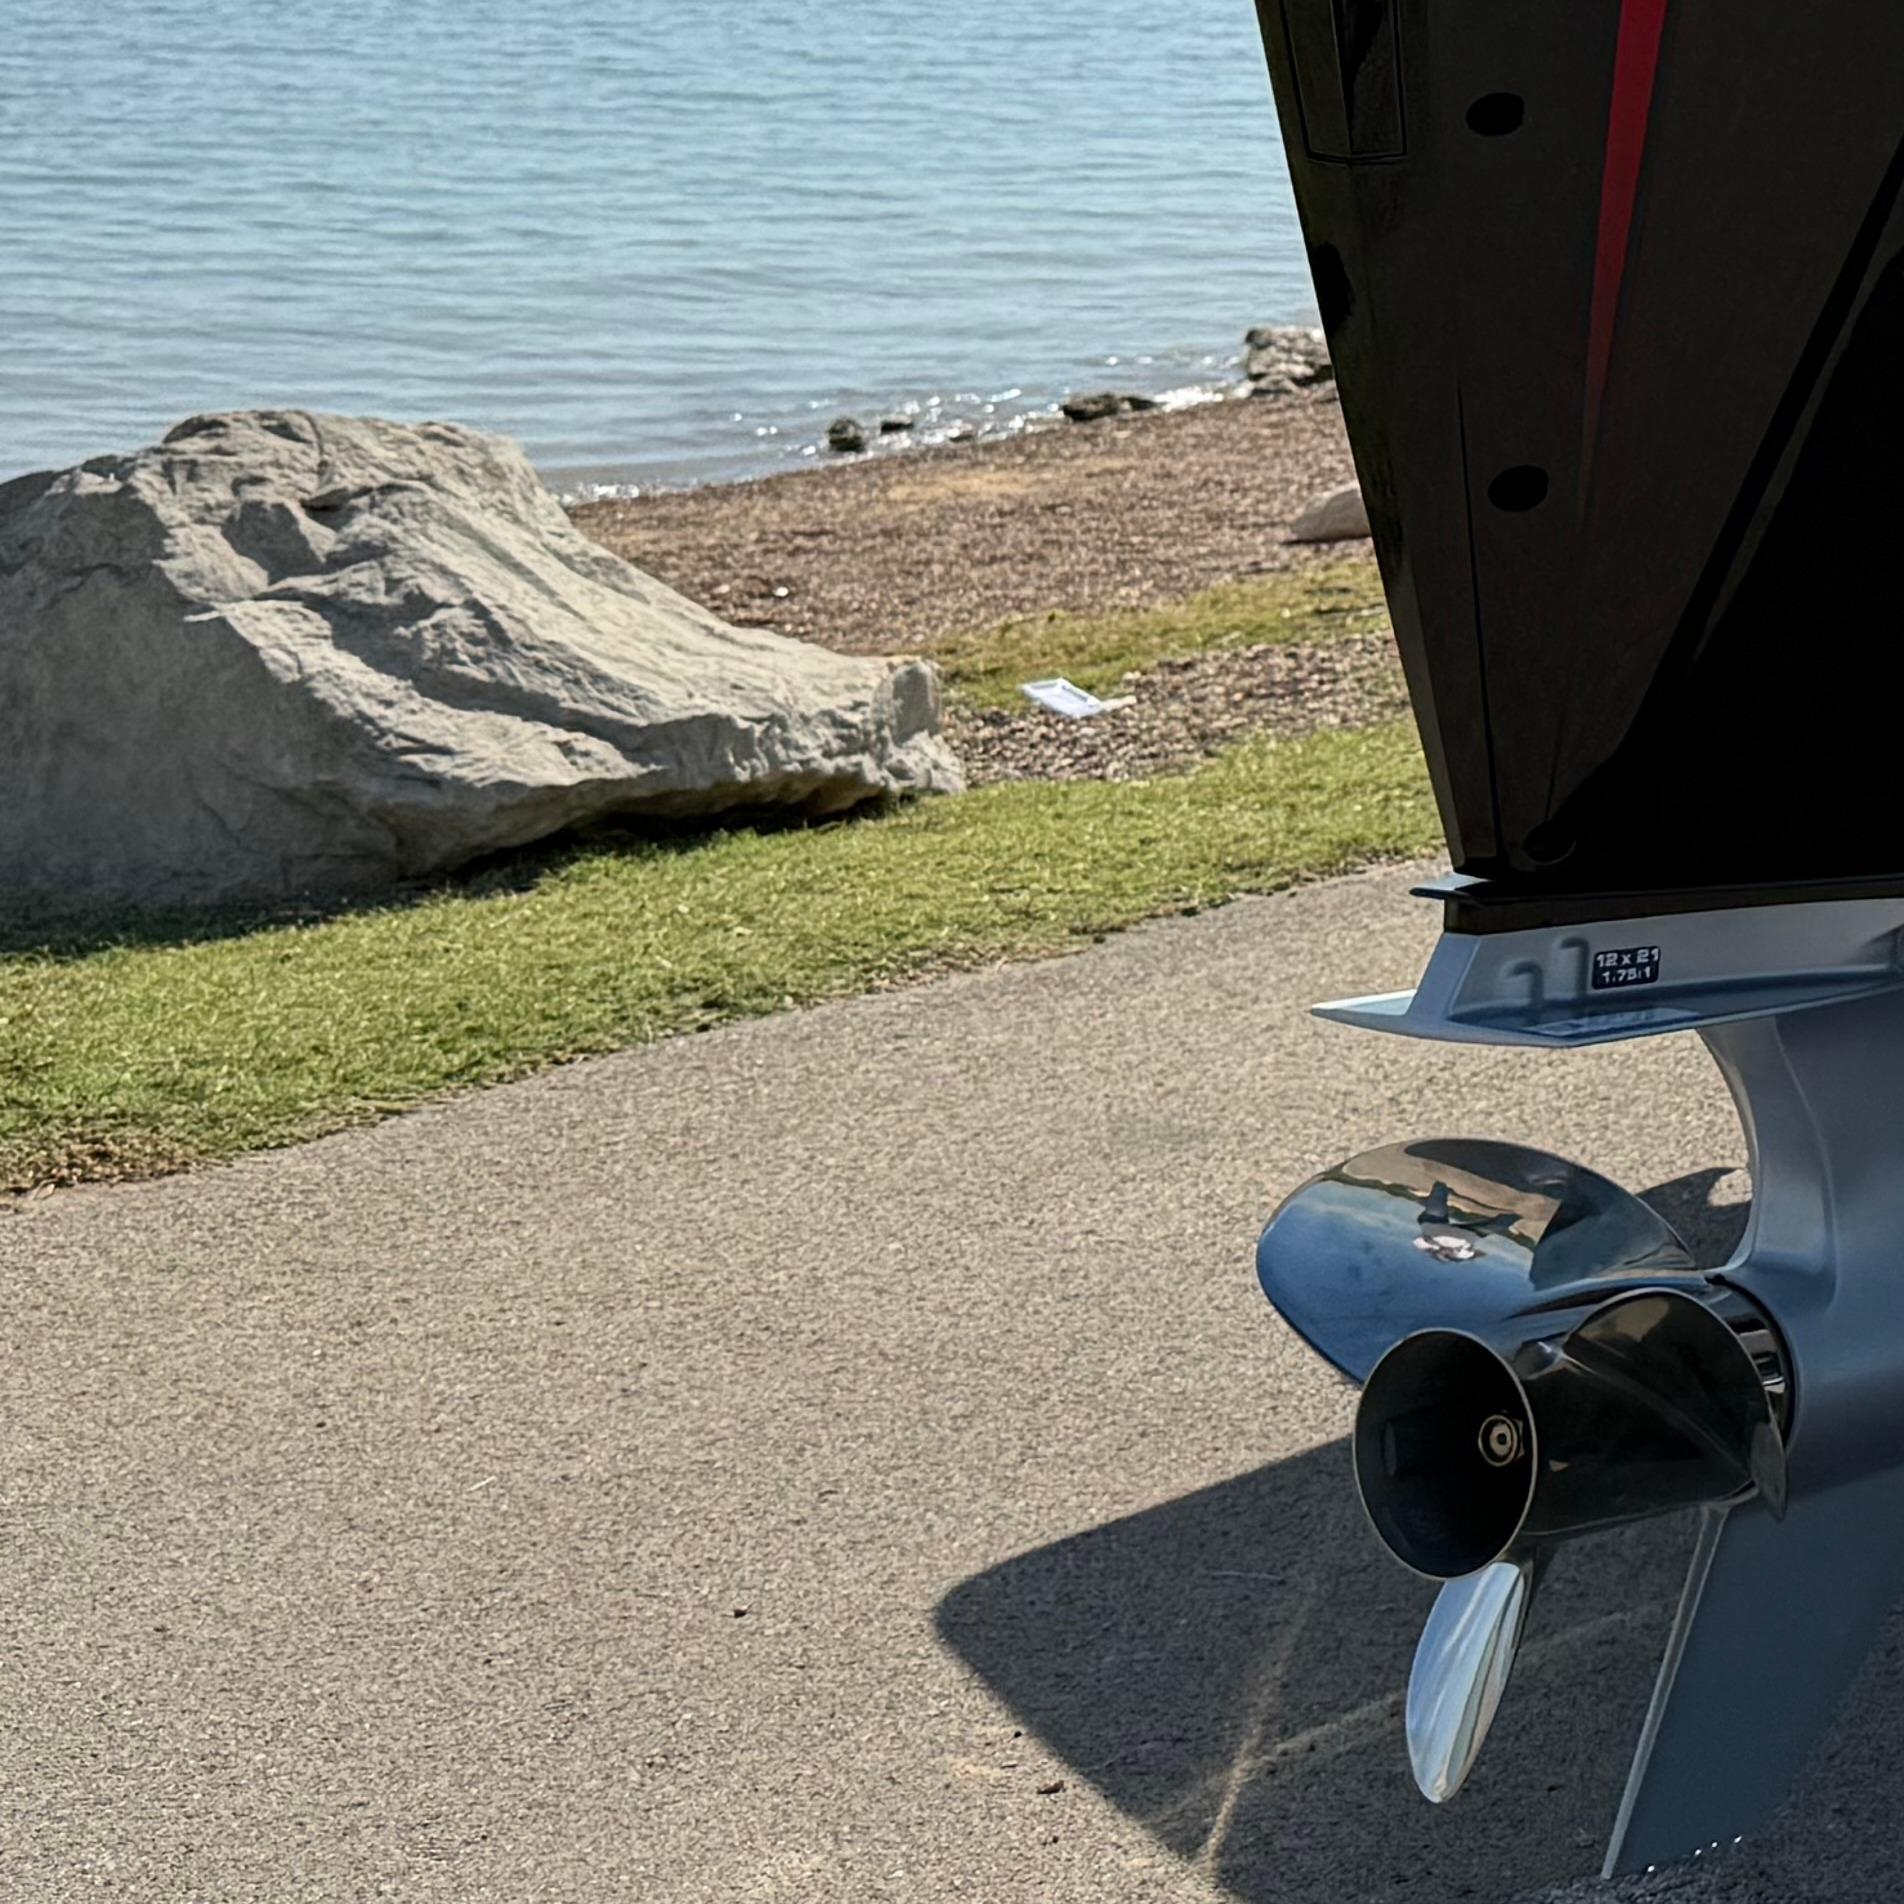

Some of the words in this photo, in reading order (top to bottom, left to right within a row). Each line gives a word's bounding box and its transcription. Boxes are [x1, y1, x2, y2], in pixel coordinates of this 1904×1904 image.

[1596, 951, 1618, 968] 12
[1636, 947, 1660, 964] 21
[1601, 965, 1652, 984] 1.75:1
